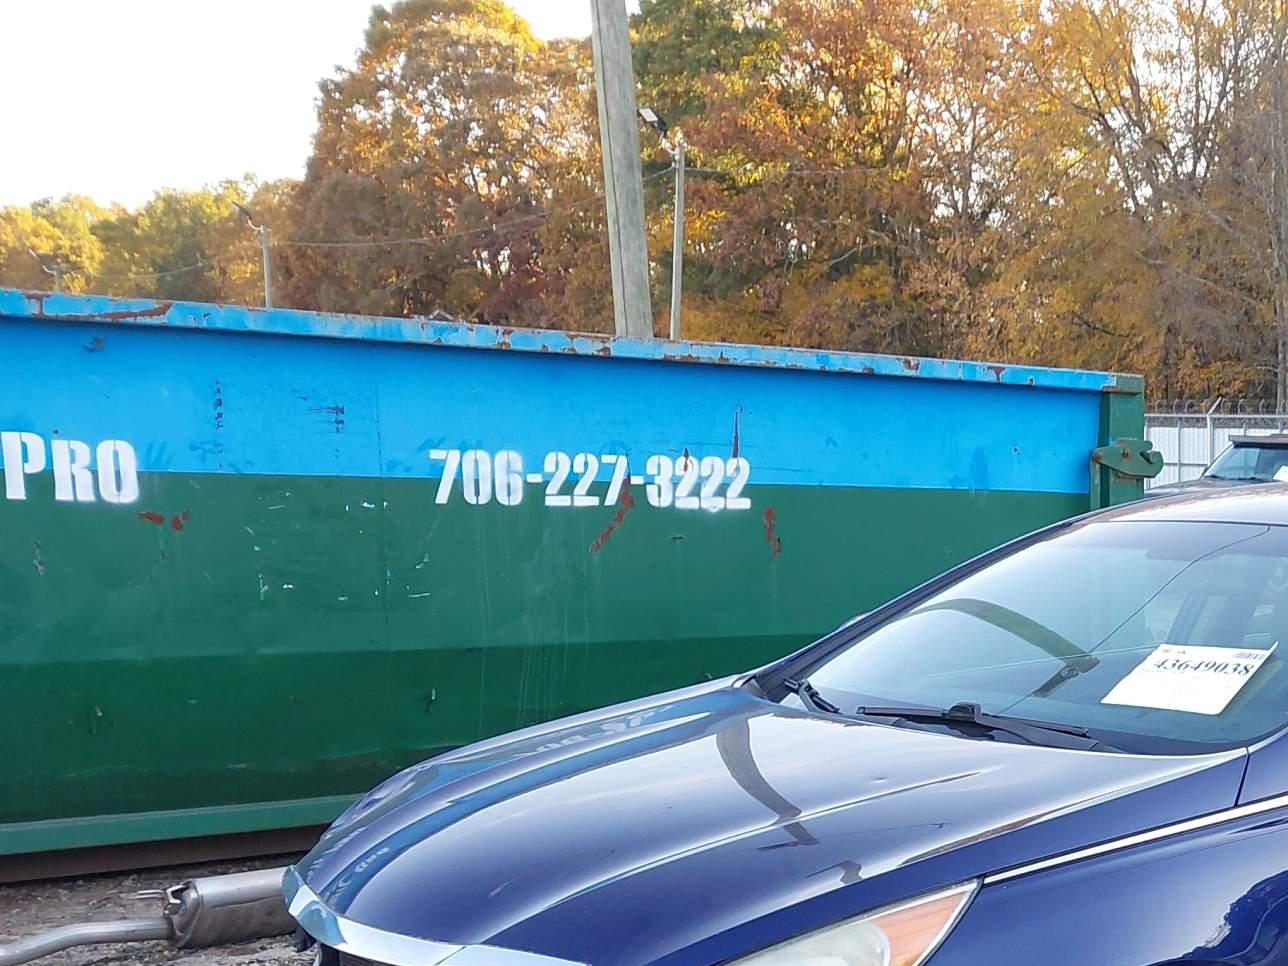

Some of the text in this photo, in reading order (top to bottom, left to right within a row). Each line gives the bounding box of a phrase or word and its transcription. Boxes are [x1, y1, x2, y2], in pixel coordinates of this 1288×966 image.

[0, 431, 139, 504] PRO
[430, 449, 752, 511] 706-227-3222
[1153, 658, 1255, 676] 43649038
